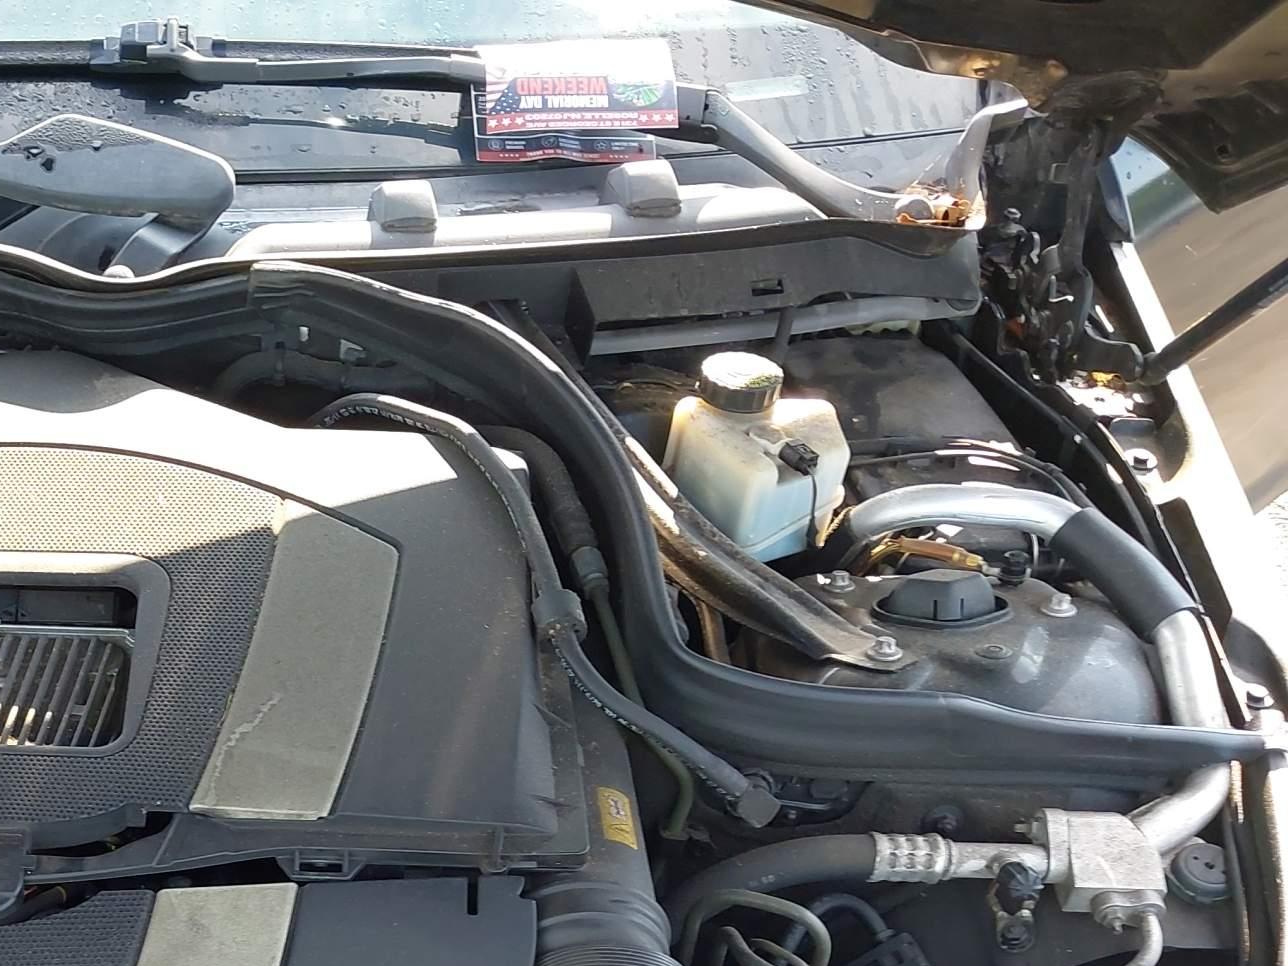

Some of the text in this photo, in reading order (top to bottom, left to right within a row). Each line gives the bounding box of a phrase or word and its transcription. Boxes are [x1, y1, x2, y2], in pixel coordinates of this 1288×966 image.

[516, 77, 608, 95] WEEKEND
[519, 95, 609, 109] MEMORIAL DAY
